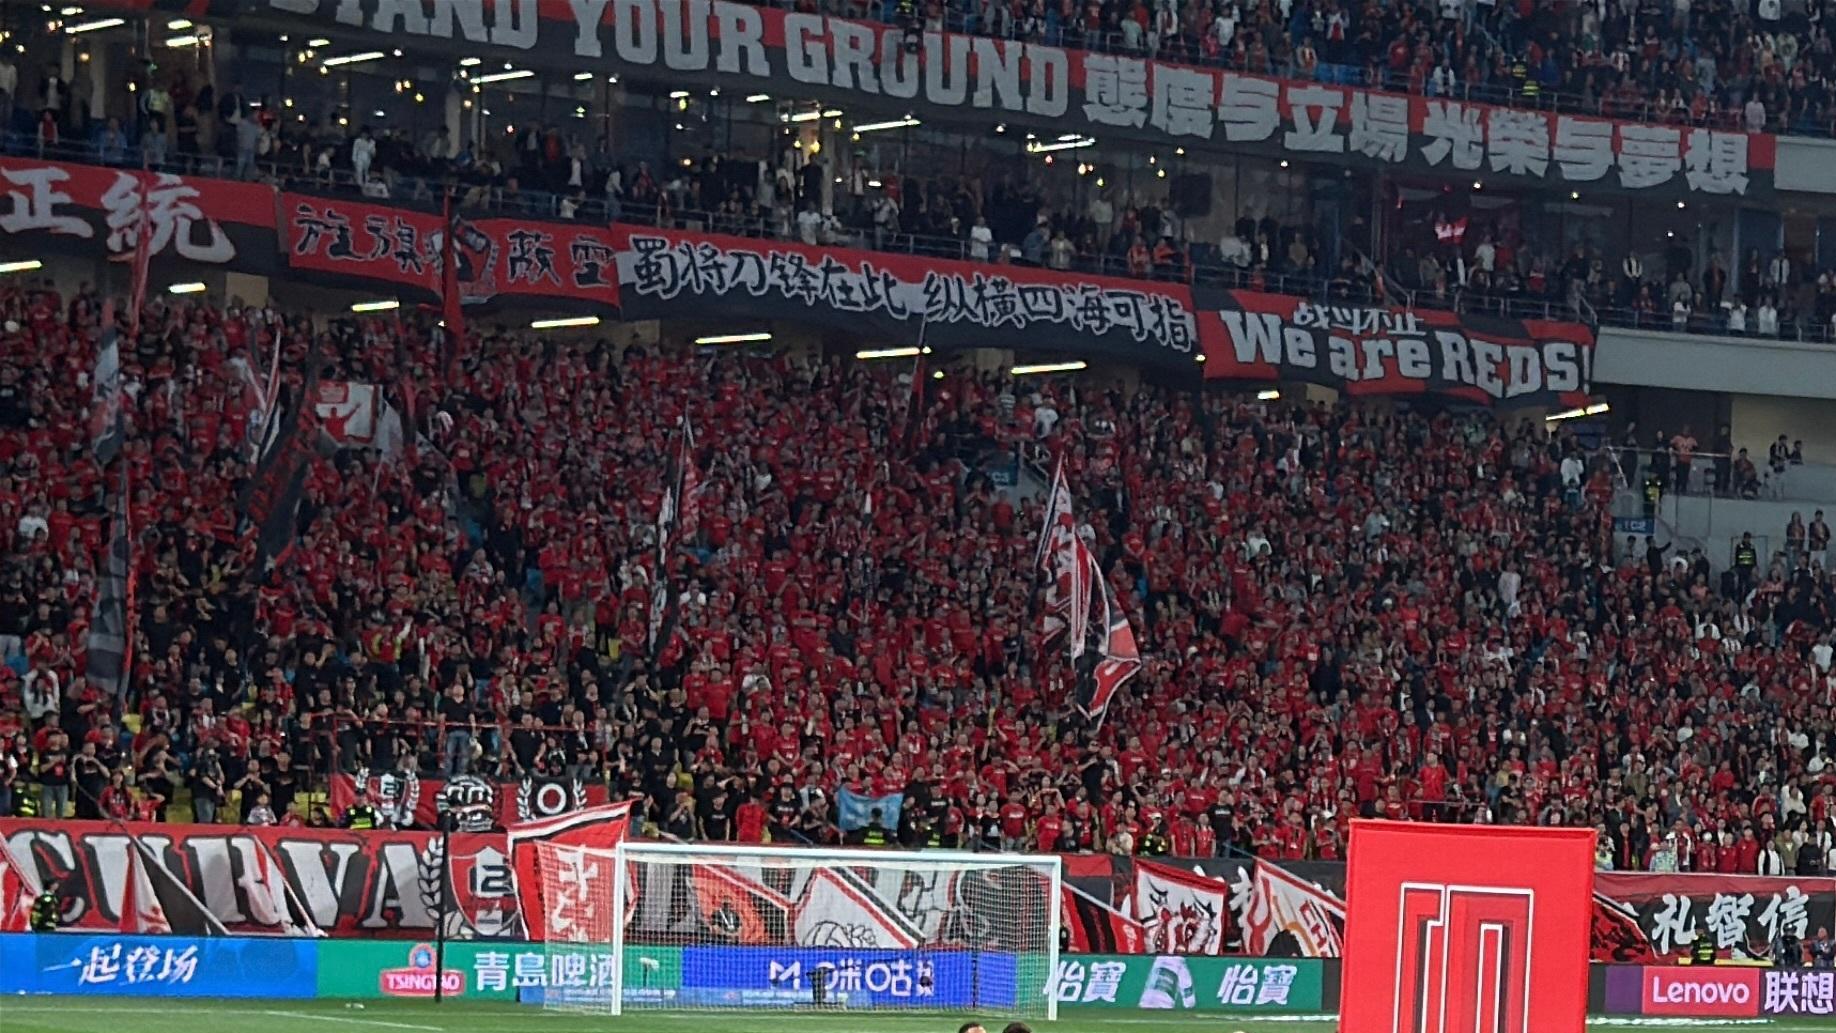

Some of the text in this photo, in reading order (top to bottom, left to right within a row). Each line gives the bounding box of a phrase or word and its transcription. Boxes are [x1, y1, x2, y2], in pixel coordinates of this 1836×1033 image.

[268, 0, 538, 49] AND
[570, 0, 770, 78] YOUR
[784, 12, 1067, 118] GROUND
[628, 233, 909, 320] 蜀将刀锋在此
[1292, 302, 1425, 336] 战斗不止
[1220, 310, 1590, 399] We are REDS!
[1650, 886, 1808, 956] 礼智信
[43, 943, 198, 985] 一起登场
[1653, 972, 1834, 1015] Lenovo 联想
